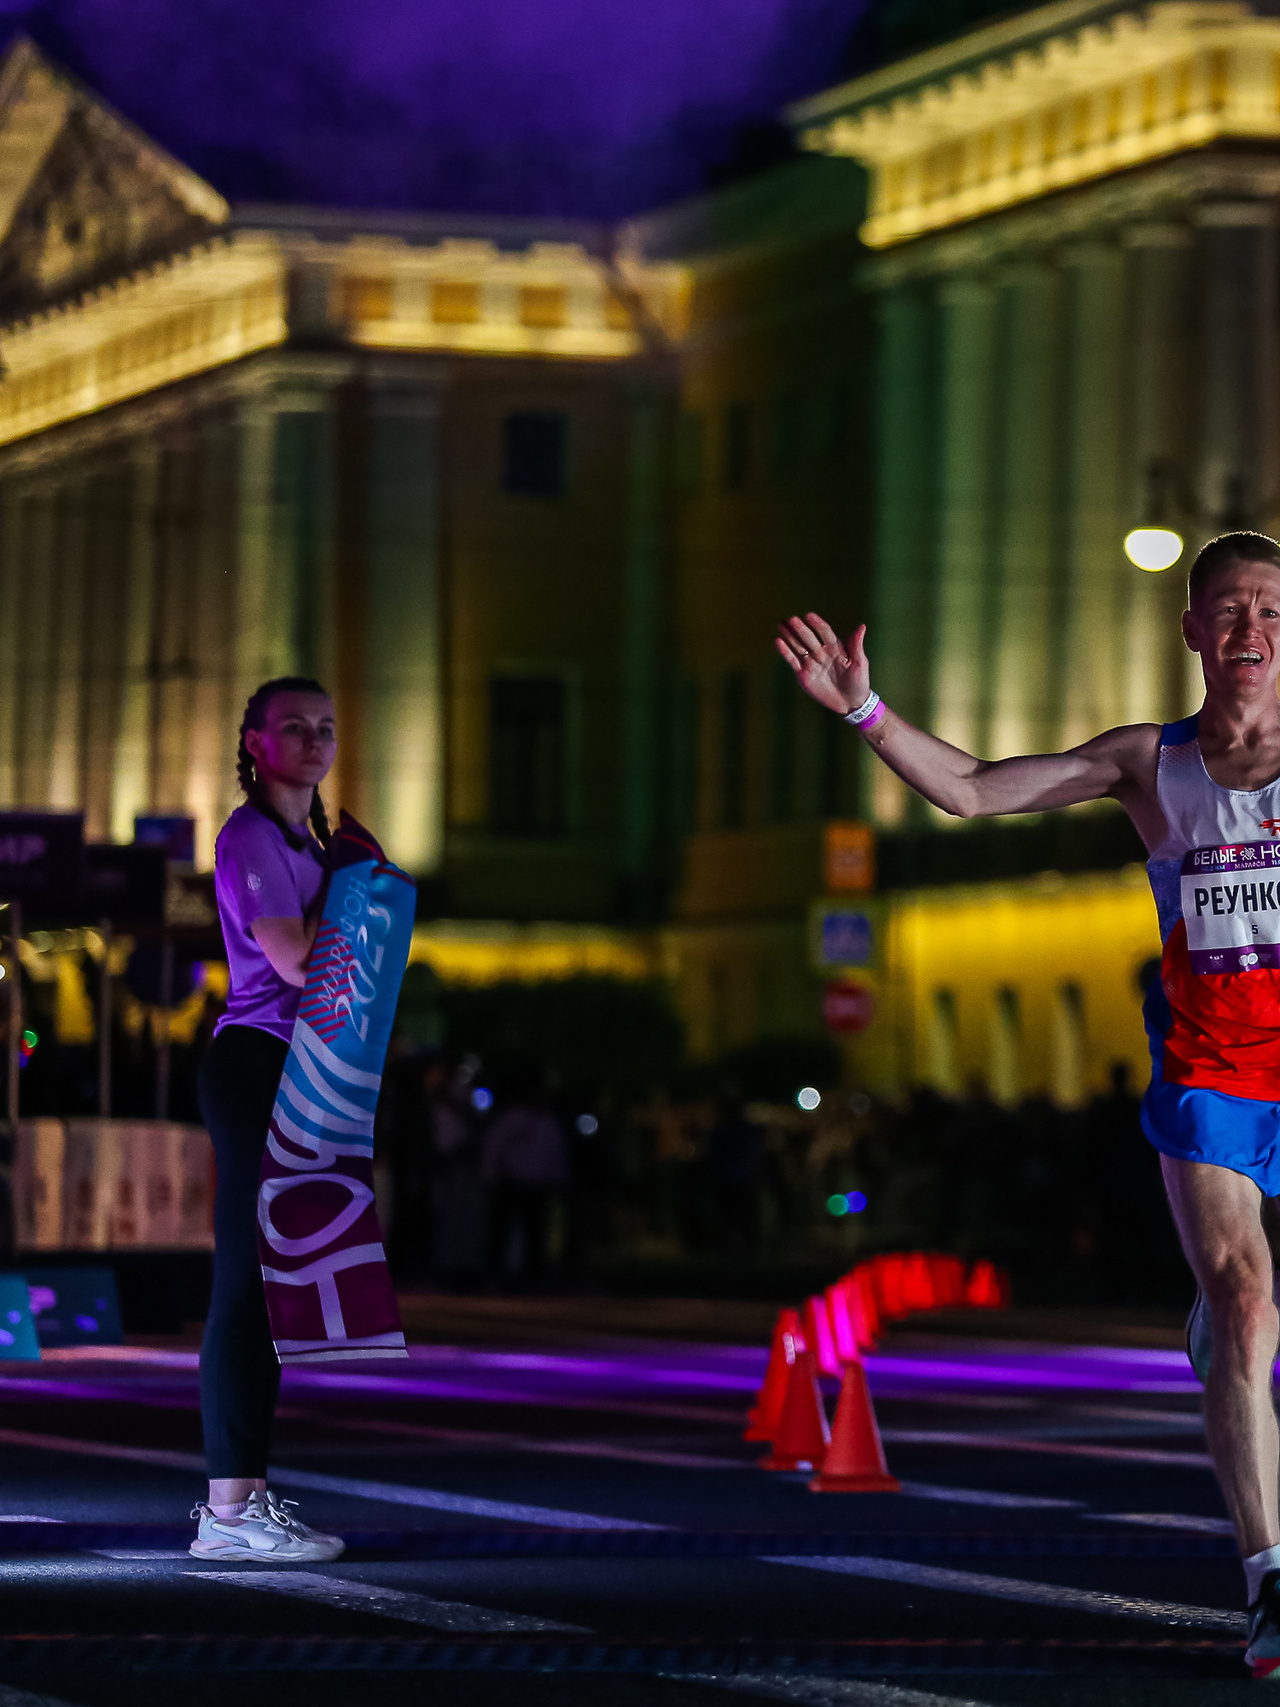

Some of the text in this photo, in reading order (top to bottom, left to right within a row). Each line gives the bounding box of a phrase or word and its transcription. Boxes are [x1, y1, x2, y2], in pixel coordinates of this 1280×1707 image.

[1194, 848, 1237, 865] БЕЛЫЕ
[1234, 860, 1266, 869] МАРАФОН
[1251, 924, 1259, 934] 5
[318, 875, 368, 1009] МАРАФОН
[335, 904, 391, 1042] 2023
